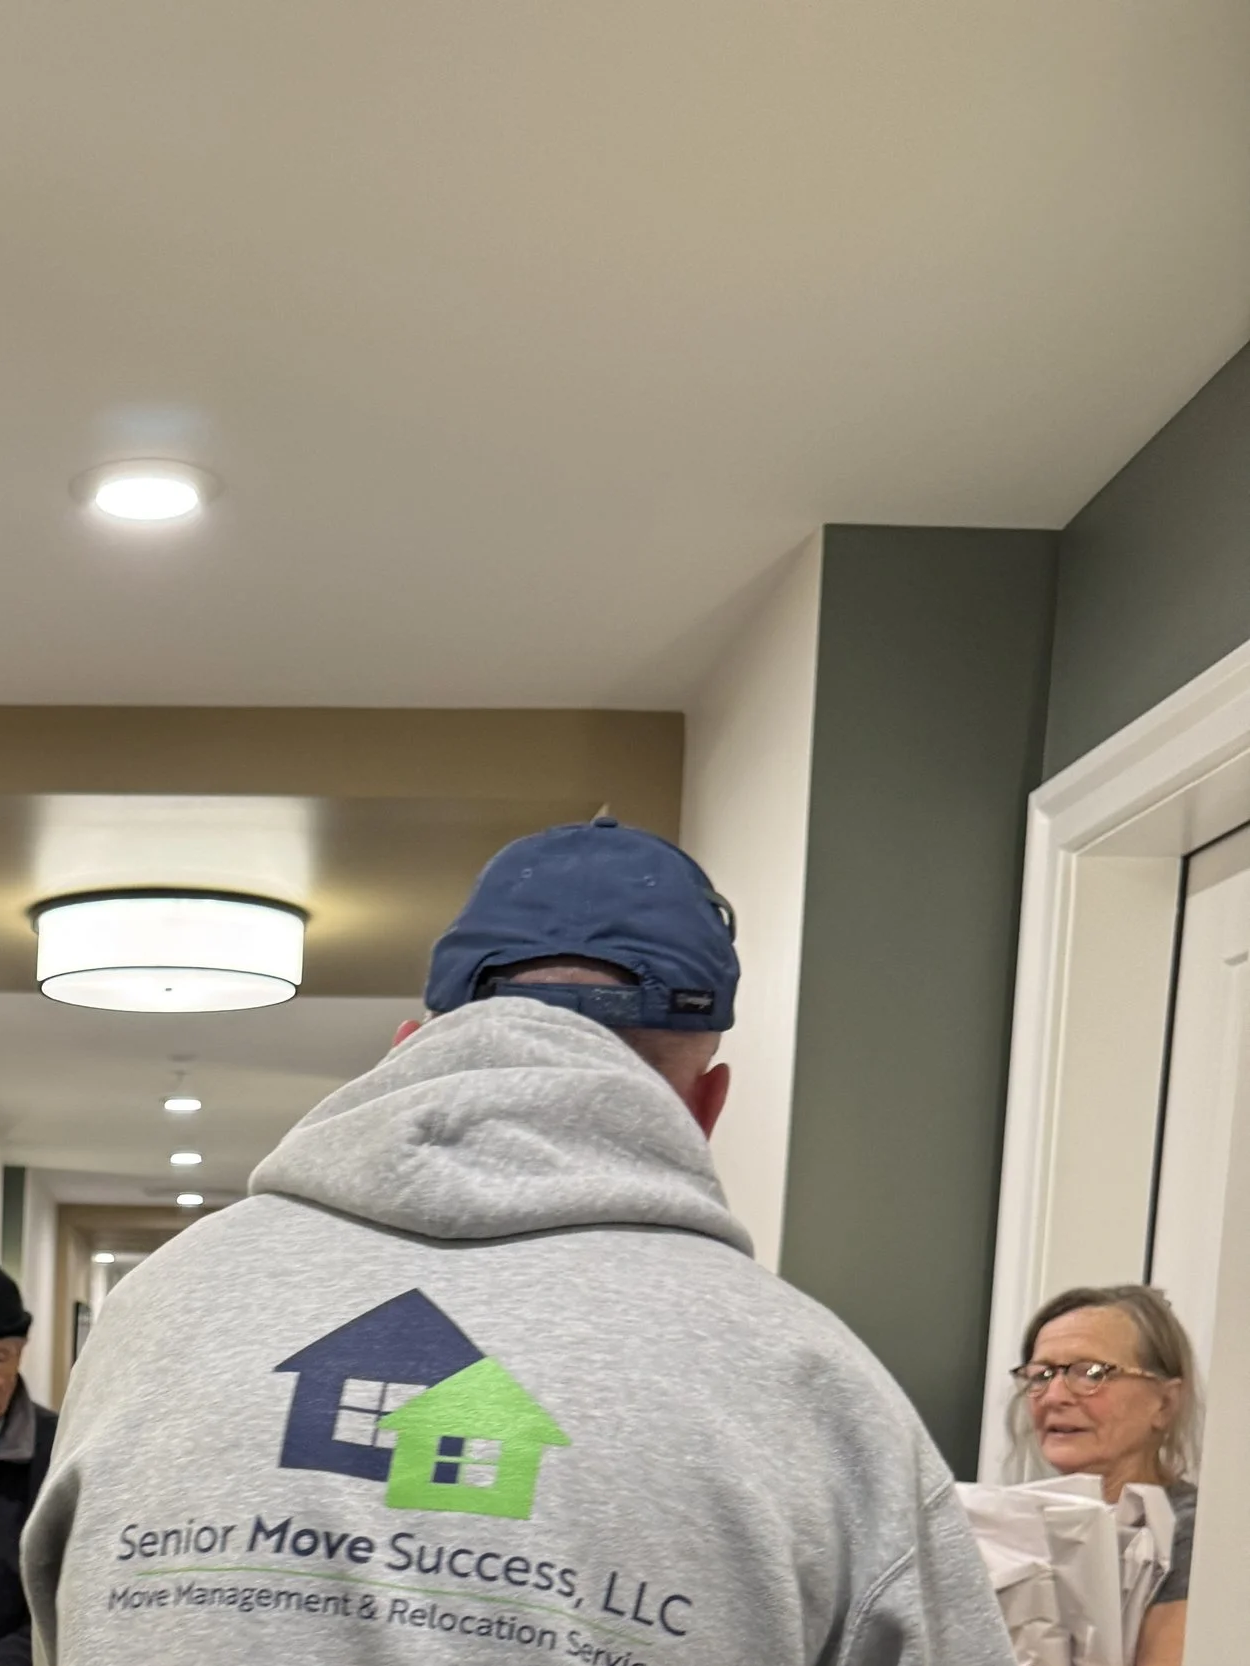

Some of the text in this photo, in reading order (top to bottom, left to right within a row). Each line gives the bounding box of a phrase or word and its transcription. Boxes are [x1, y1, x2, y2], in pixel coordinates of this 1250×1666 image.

[108, 1586, 171, 1611] Move
[173, 1581, 351, 1616] Management
[357, 1594, 378, 1619] &
[387, 1598, 557, 1650] Relocation
[118, 1514, 693, 1636] Senior Move Success, LLC
